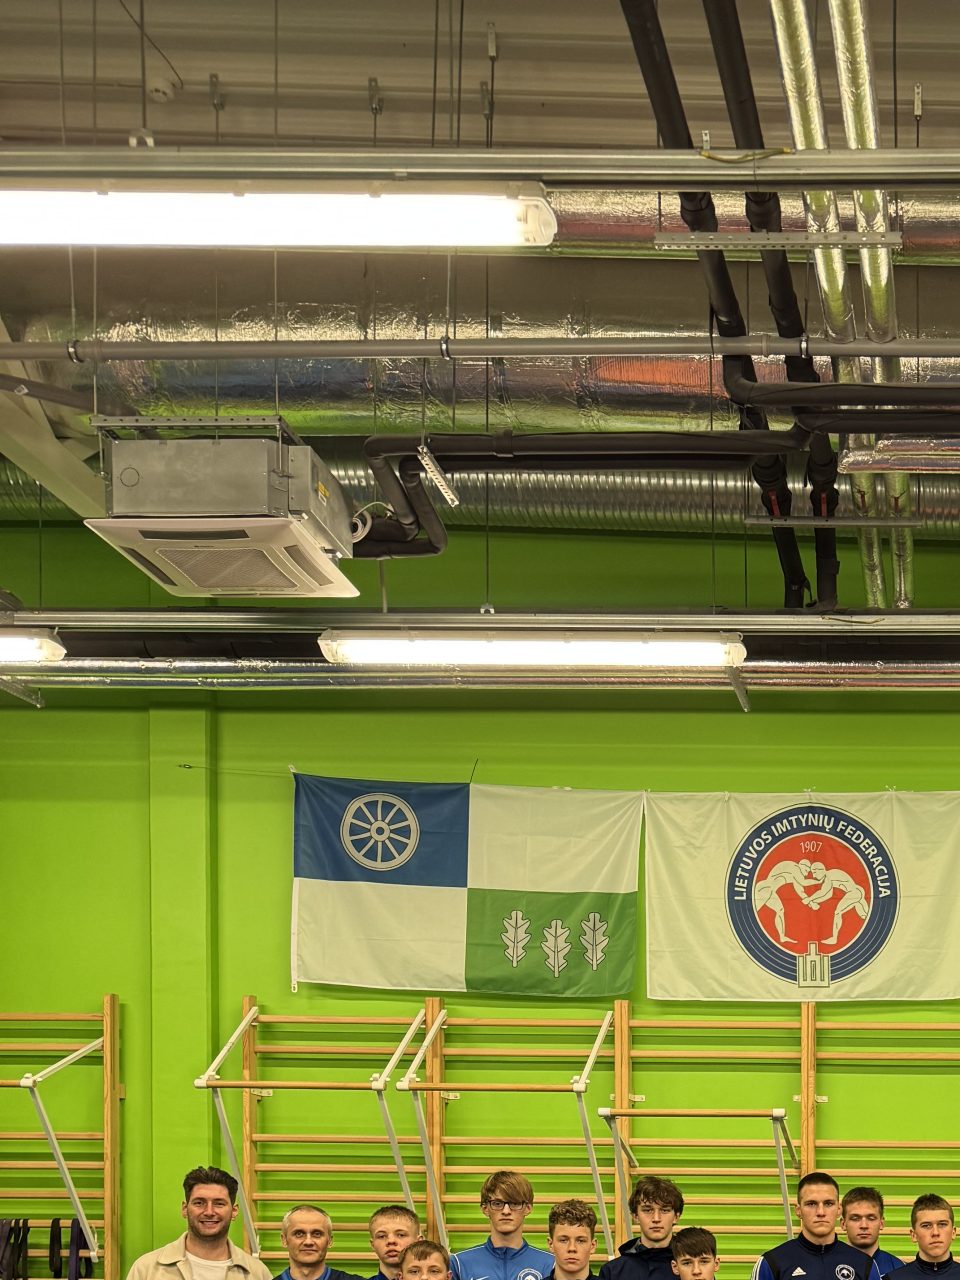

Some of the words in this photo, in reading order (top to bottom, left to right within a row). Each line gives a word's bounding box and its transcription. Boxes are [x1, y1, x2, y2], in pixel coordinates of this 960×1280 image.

[734, 830, 772, 900] LIETUVOS
[771, 813, 835, 837] IMTYNIŲ
[836, 820, 891, 898] FEDERACIJA
[800, 841, 823, 853] 1907
